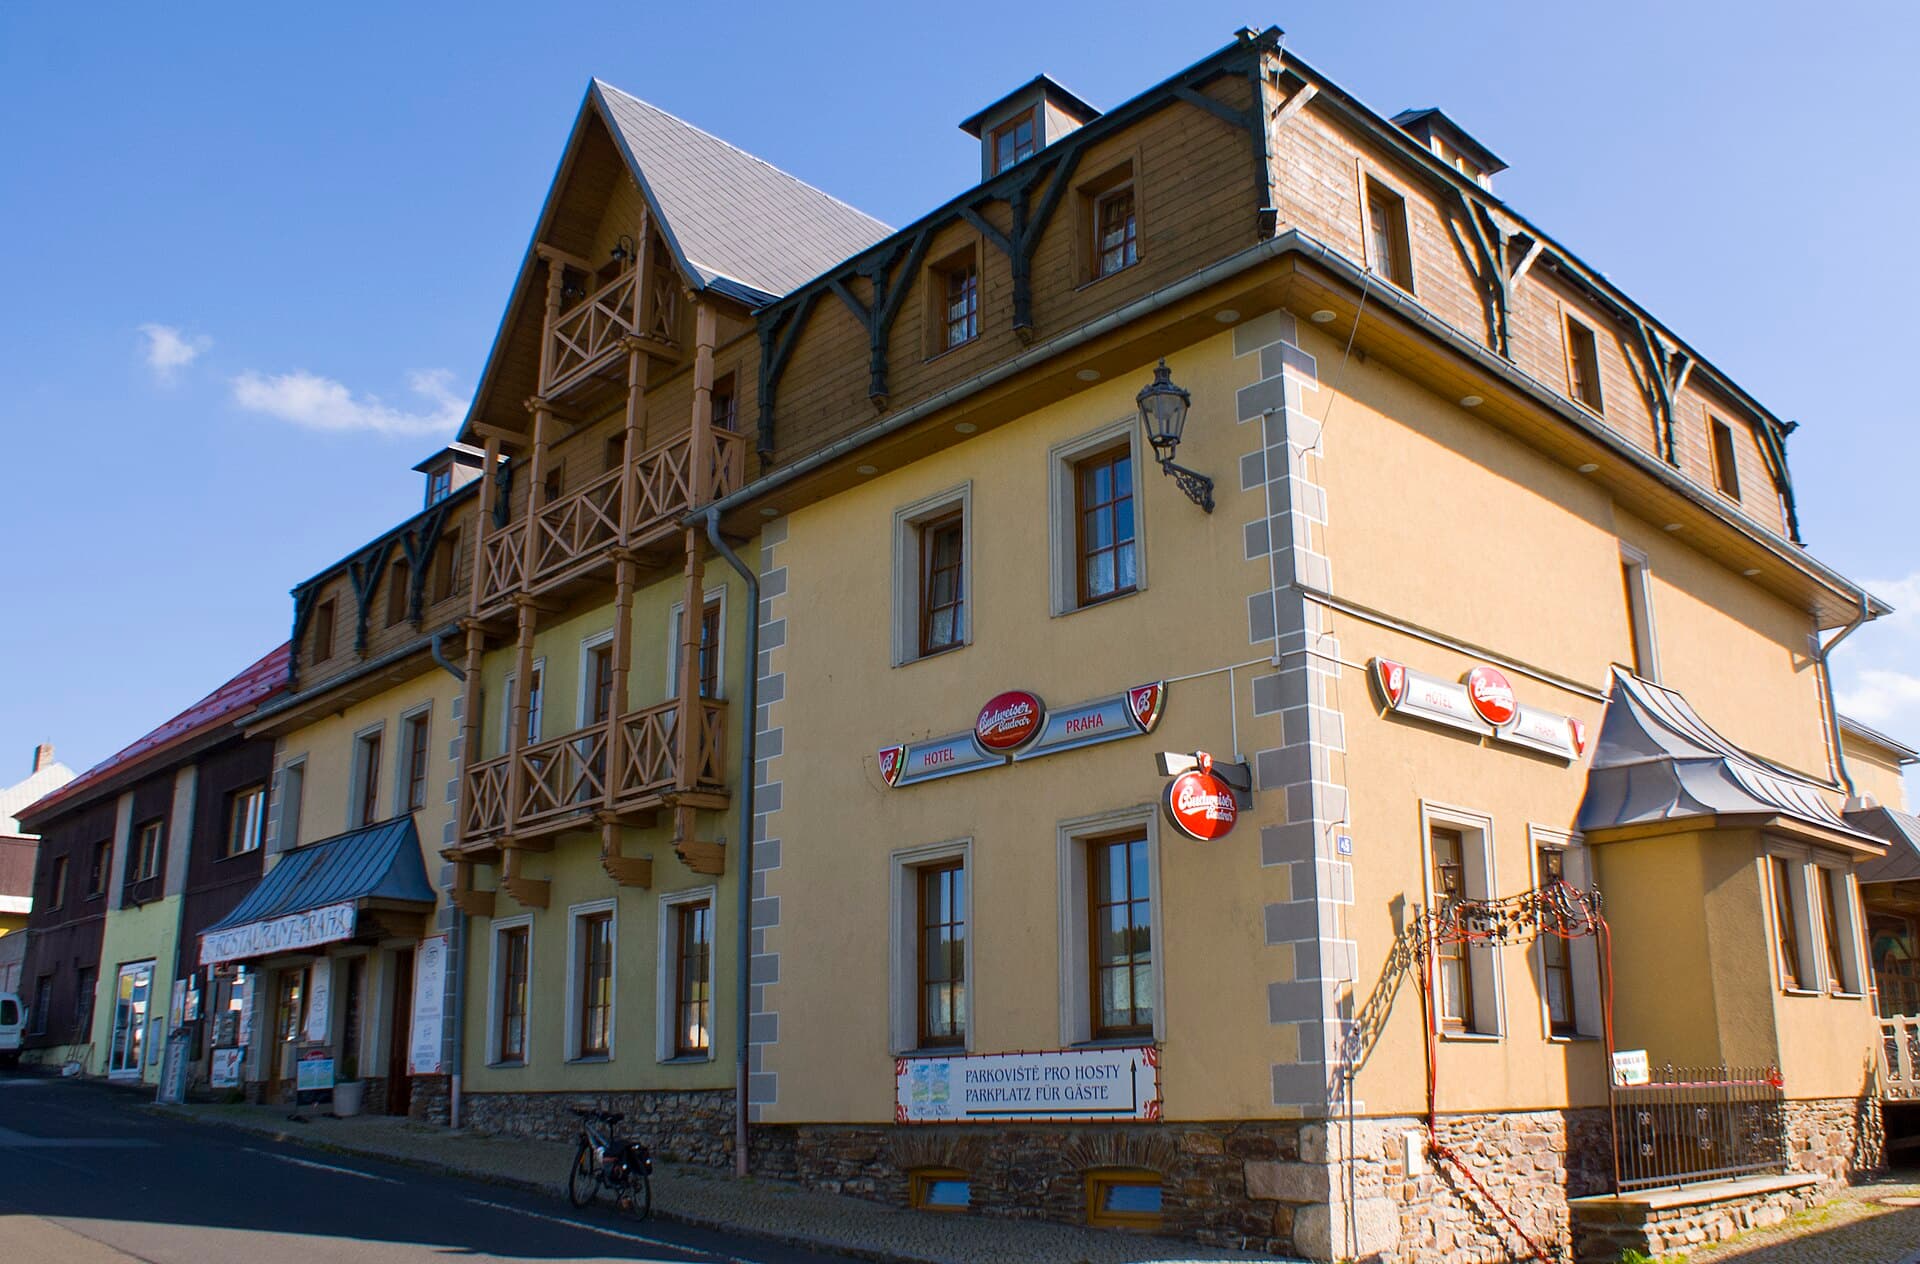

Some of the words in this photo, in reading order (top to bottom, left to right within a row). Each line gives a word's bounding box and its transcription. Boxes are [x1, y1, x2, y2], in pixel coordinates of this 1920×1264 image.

[979, 701, 1033, 735] Budweiser
[998, 714, 1031, 733] Budvar
[1066, 712, 1104, 734] PRAHA
[924, 747, 955, 766] HOTEL
[965, 1065, 1040, 1083] PARKOVIŠTĚ
[1044, 1065, 1070, 1081] PRO
[1075, 1064, 1120, 1080] HOSTY
[965, 1087, 1031, 1102] PARKPLATZ
[1036, 1084, 1060, 1100] FÜR
[1064, 1083, 1109, 1100] GÄSTE
